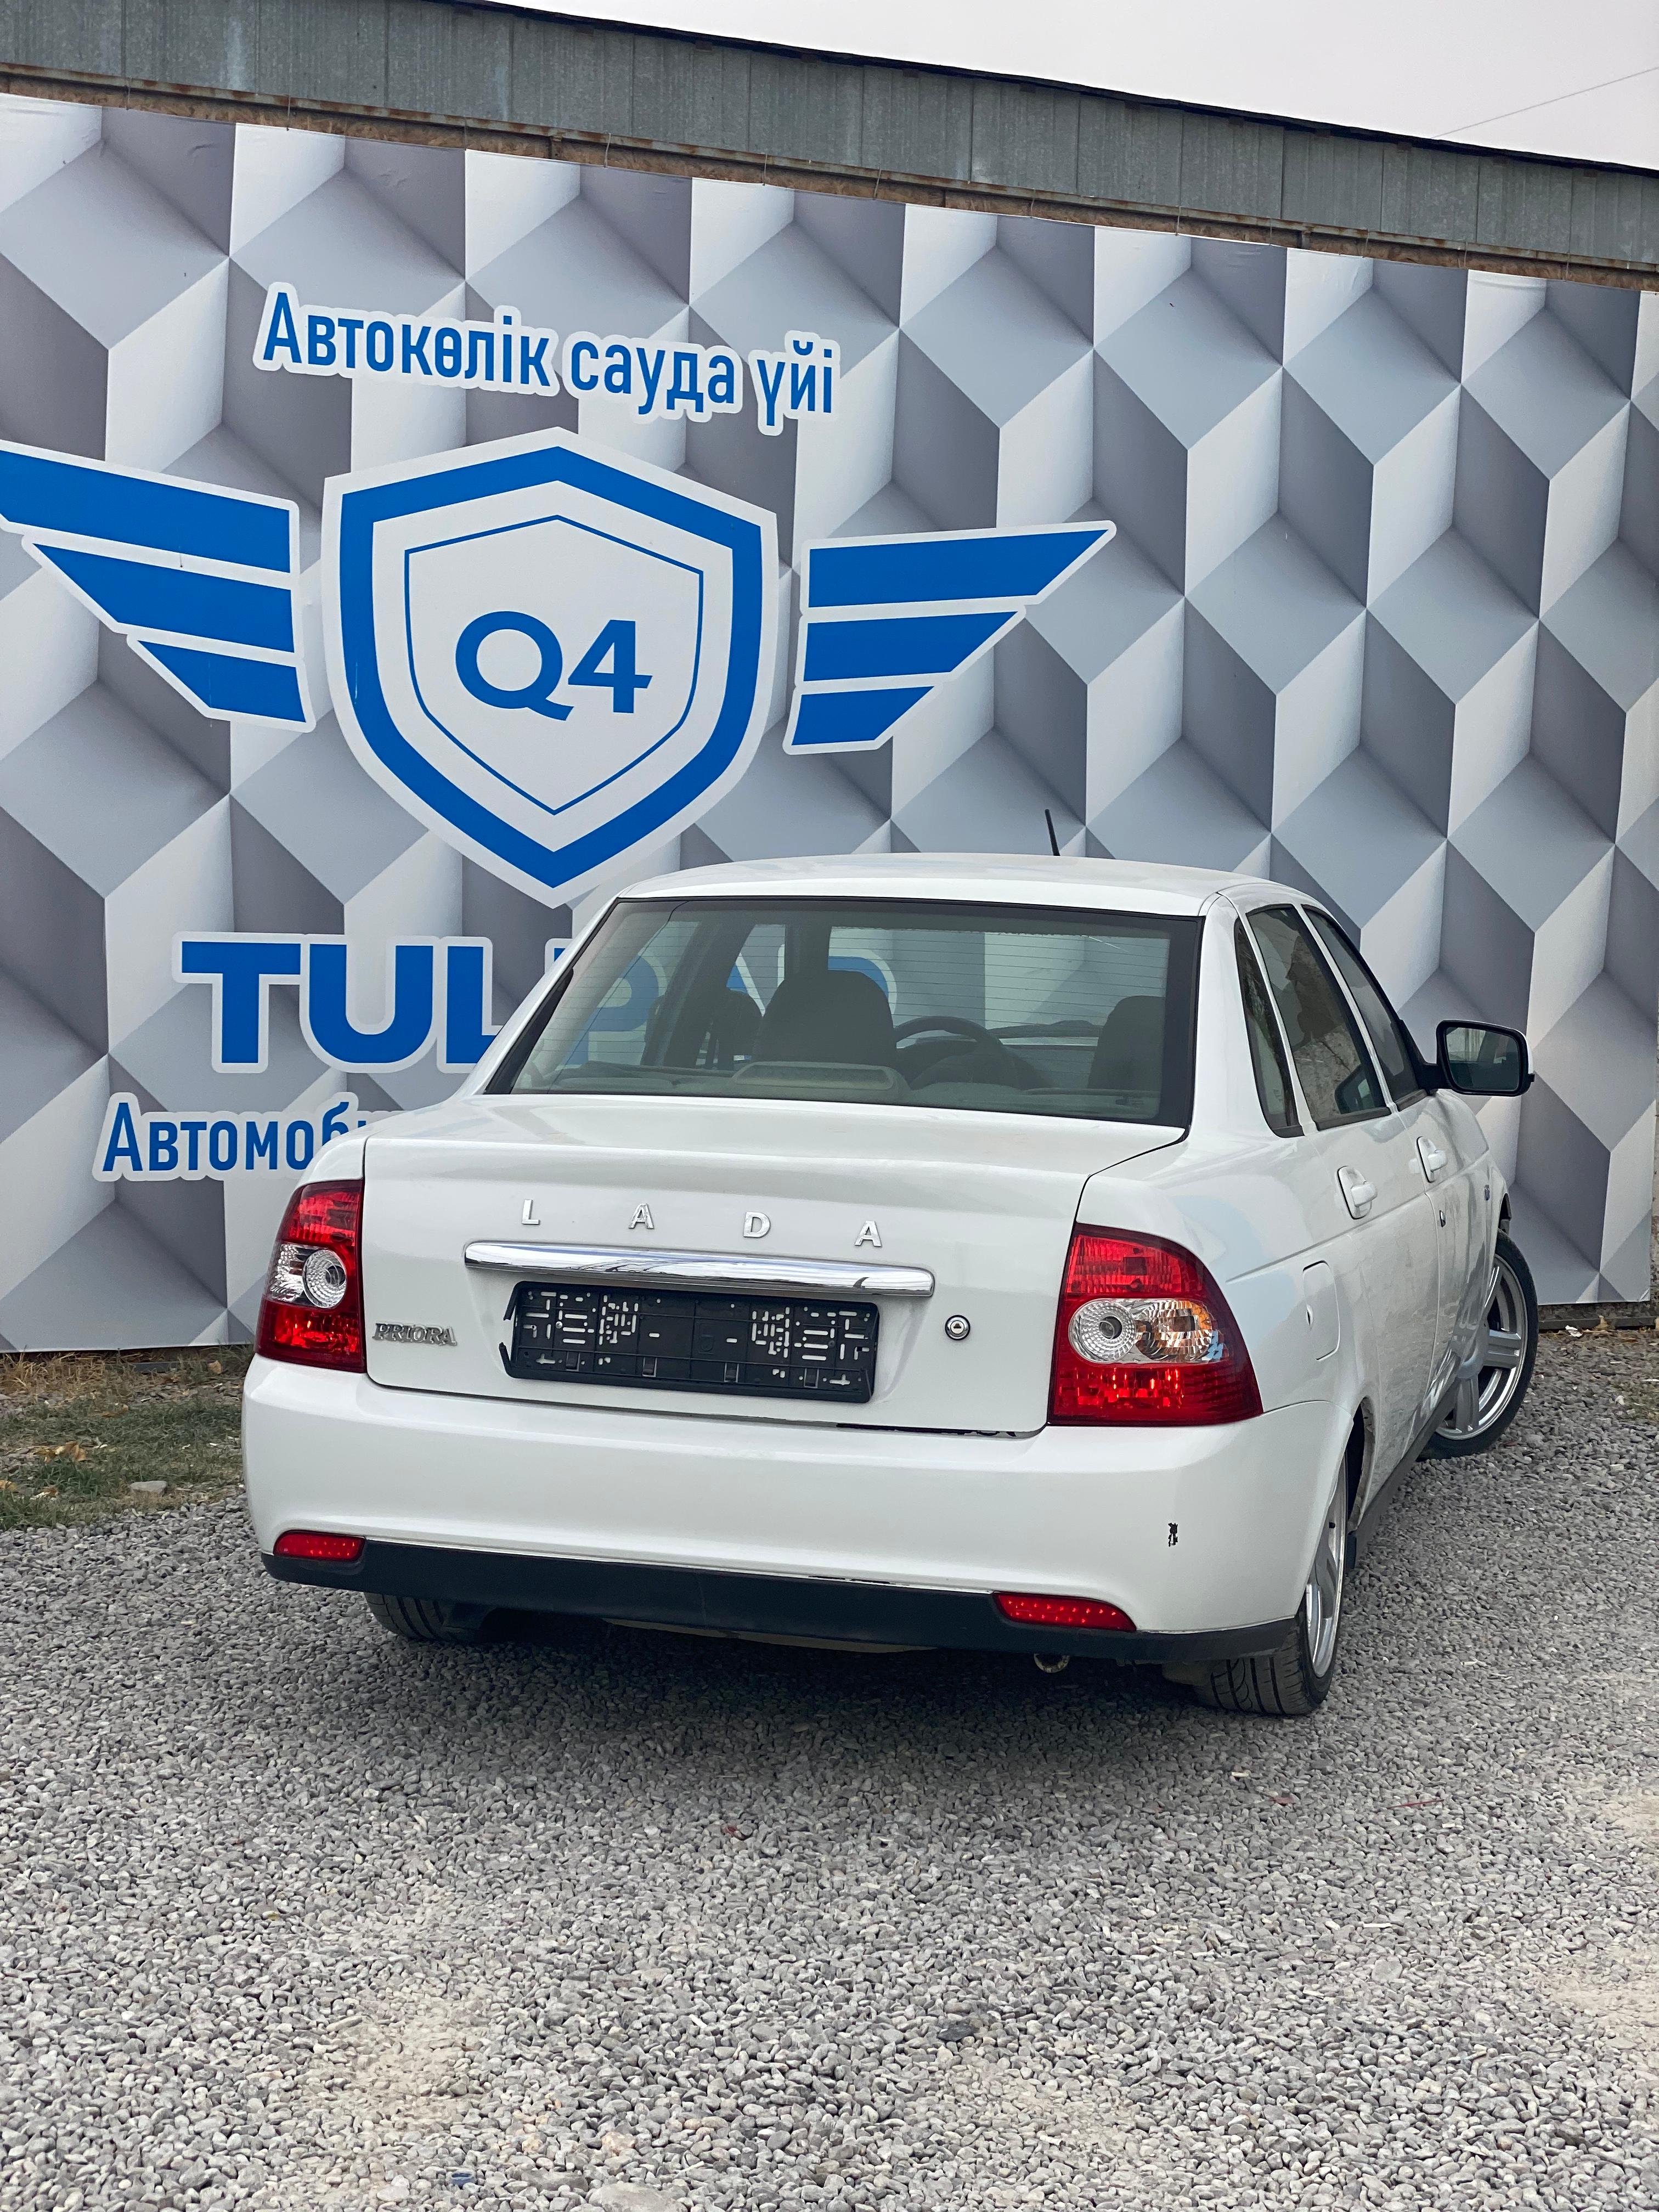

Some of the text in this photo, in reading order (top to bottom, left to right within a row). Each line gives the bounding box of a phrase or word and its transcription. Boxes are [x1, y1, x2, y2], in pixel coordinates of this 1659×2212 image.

[263, 292, 833, 426] Автокөлік сауда үйі
[455, 611, 653, 721] Q4
[103, 1102, 366, 1172] Автомоб
[522, 1199, 883, 1248] LADA
[372, 1321, 458, 1346] PRIORA
